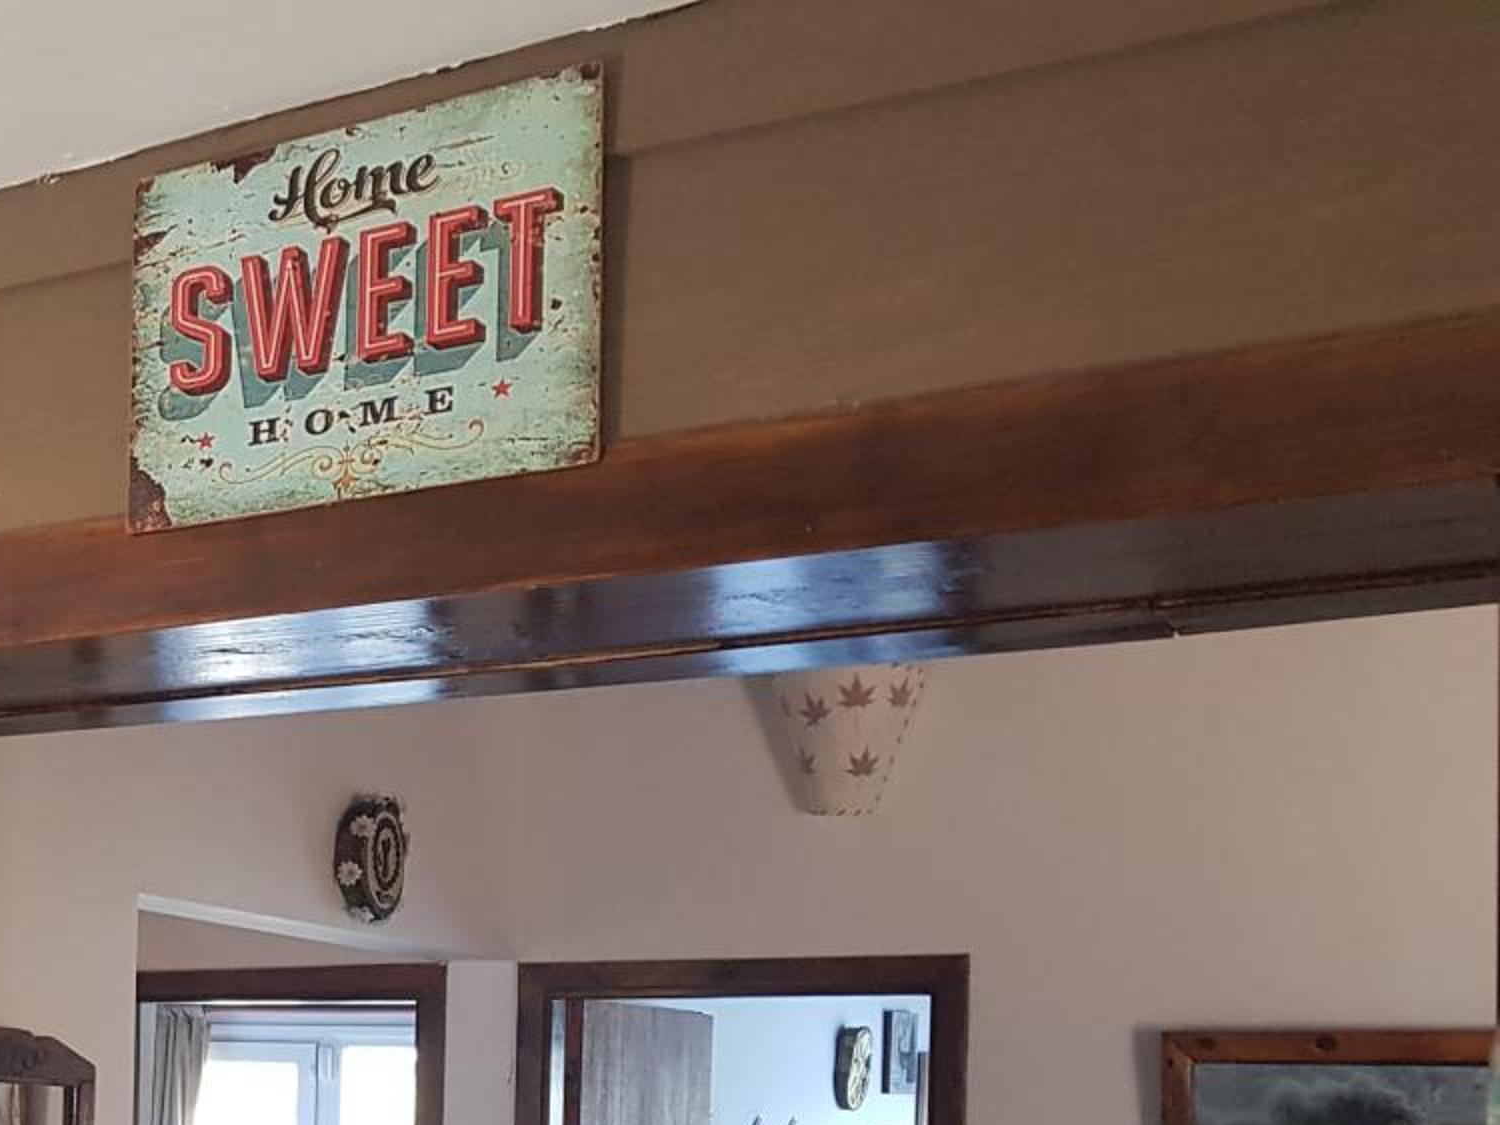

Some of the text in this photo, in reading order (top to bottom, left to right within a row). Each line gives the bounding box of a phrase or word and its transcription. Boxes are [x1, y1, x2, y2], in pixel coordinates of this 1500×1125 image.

[269, 148, 440, 232] Home
[168, 186, 565, 398] SWEET
[248, 386, 454, 447] HOME
